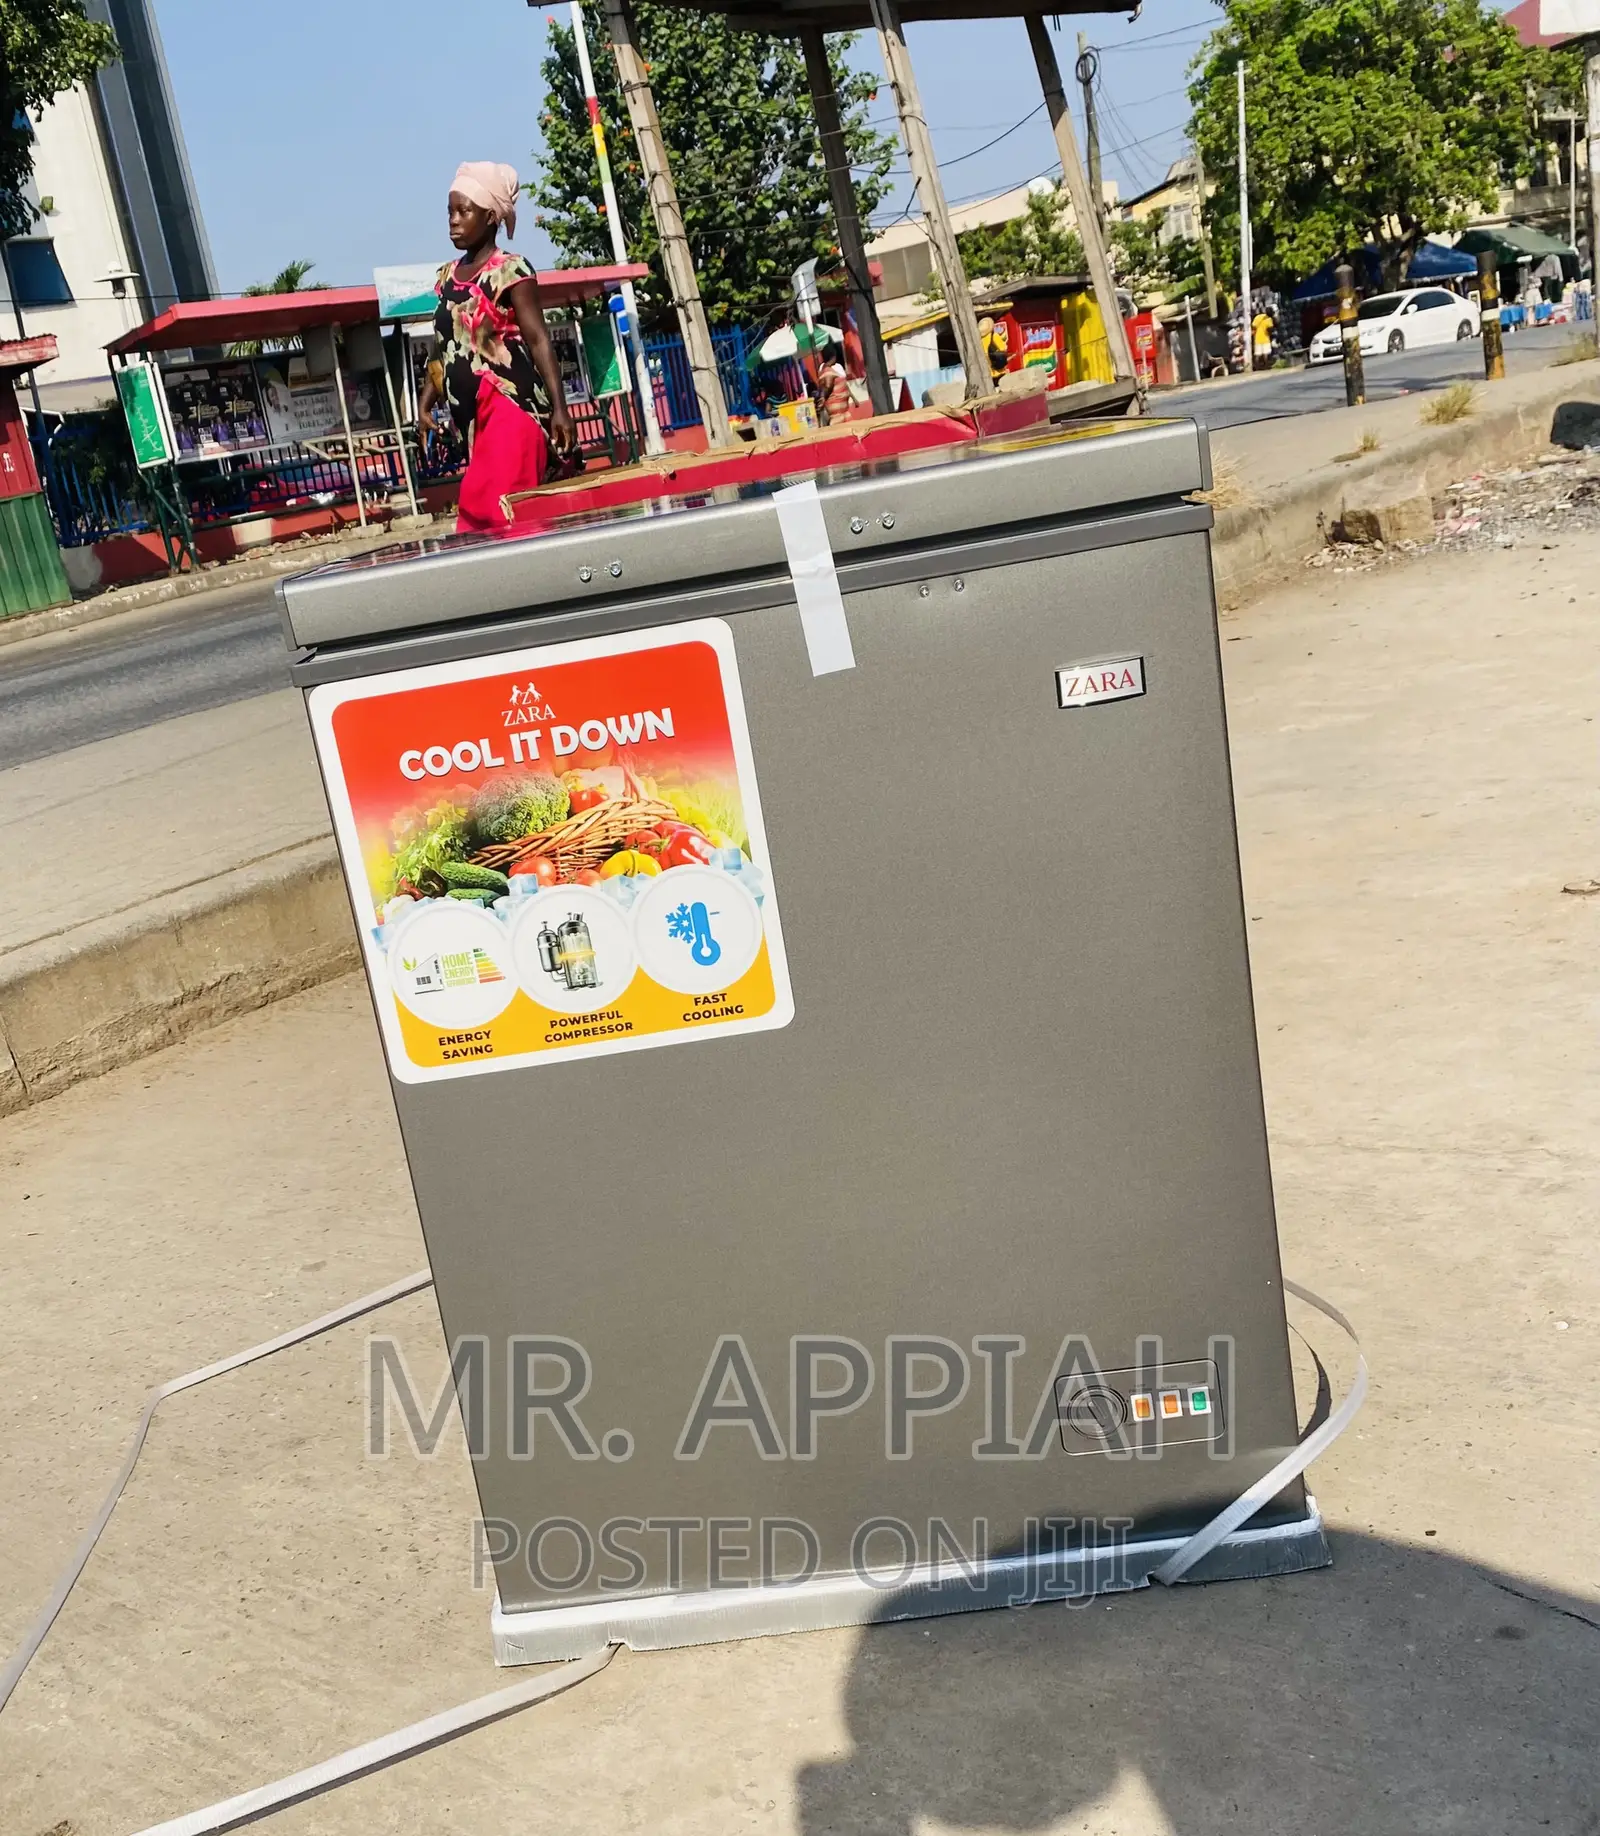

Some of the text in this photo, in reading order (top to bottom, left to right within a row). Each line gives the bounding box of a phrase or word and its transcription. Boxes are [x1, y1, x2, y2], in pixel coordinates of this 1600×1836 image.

[1065, 668, 1136, 697] ZARA
[501, 703, 556, 727] ZARA
[399, 707, 675, 781] COOL IT DOWN
[441, 951, 473, 969] HOME
[443, 966, 475, 980] ENERGY
[693, 992, 728, 1007] FAST
[549, 1010, 624, 1029] POWERFUL
[682, 1004, 744, 1023] COOLING
[438, 1030, 492, 1046] ENERGY
[544, 1022, 634, 1043] COMPRESSOR
[442, 1043, 494, 1060] SAVING
